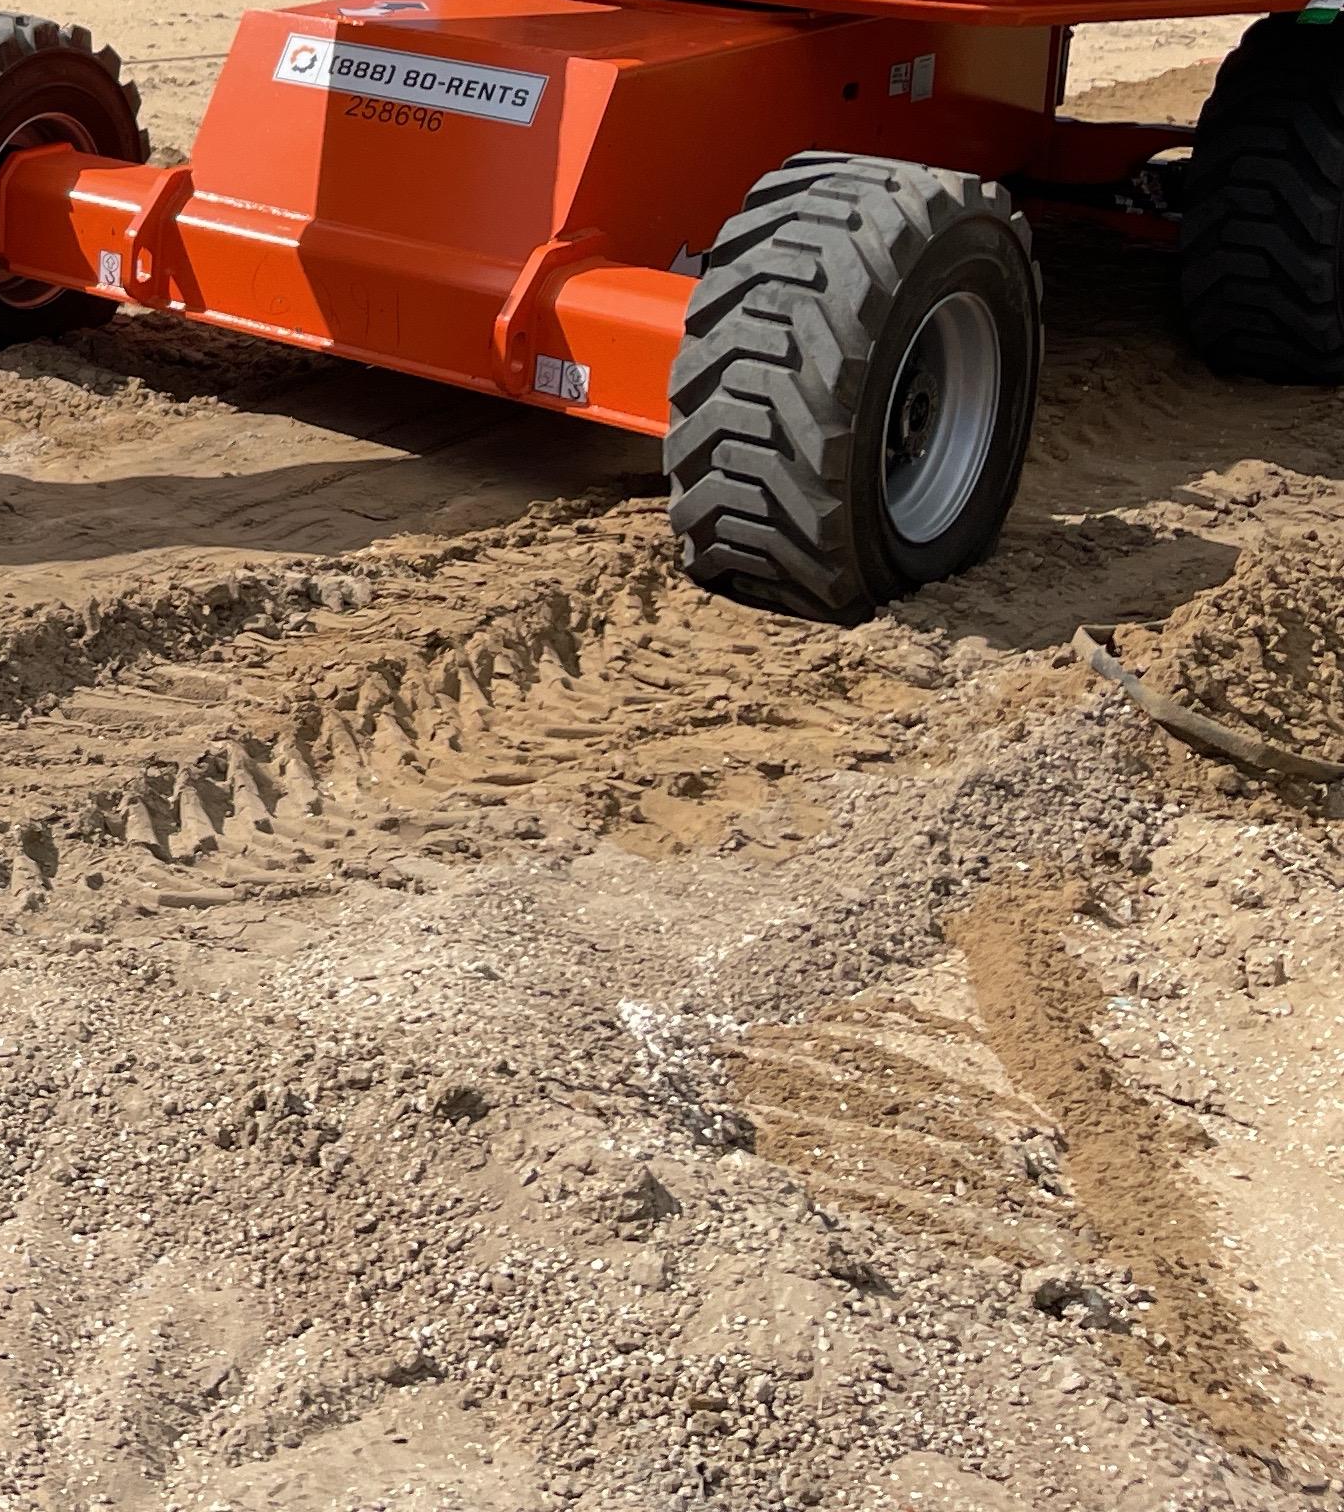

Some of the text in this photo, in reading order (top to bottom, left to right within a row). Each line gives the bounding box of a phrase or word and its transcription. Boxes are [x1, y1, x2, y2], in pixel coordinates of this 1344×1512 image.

[328, 55, 531, 108] (888) 80-RENTS
[344, 95, 445, 133] 258696
